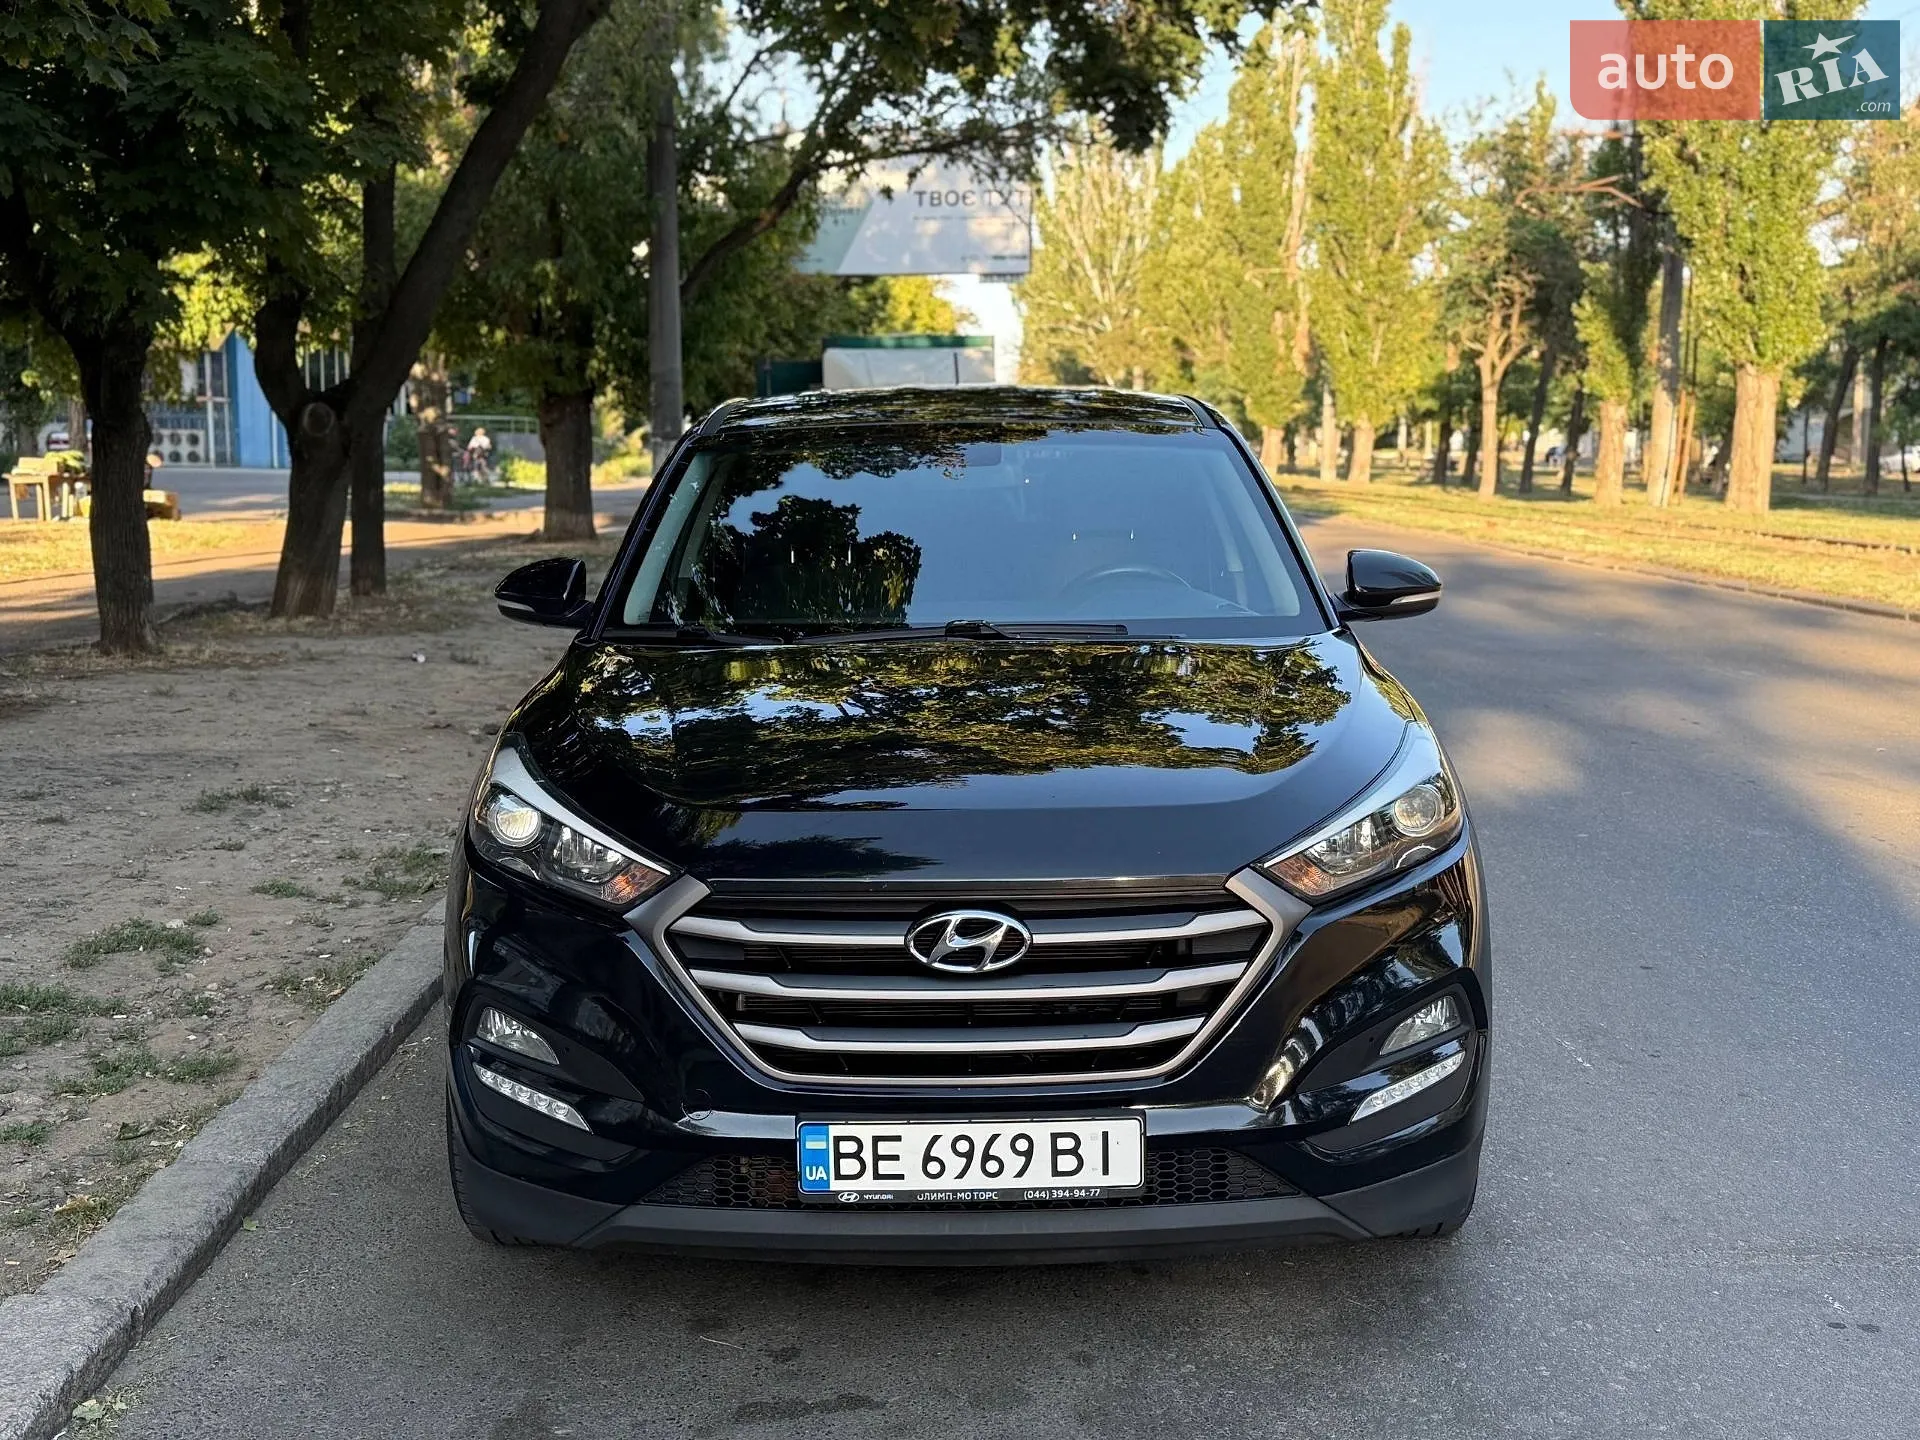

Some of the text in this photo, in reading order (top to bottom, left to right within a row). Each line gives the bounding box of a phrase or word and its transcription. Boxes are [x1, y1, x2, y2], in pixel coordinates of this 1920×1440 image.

[913, 189, 977, 208] ТВОЄ
[833, 1131, 1110, 1181] BE 6969 BI
[805, 1166, 828, 1181] UA
[1024, 1188, 1101, 1200] (044) 394-94-77
